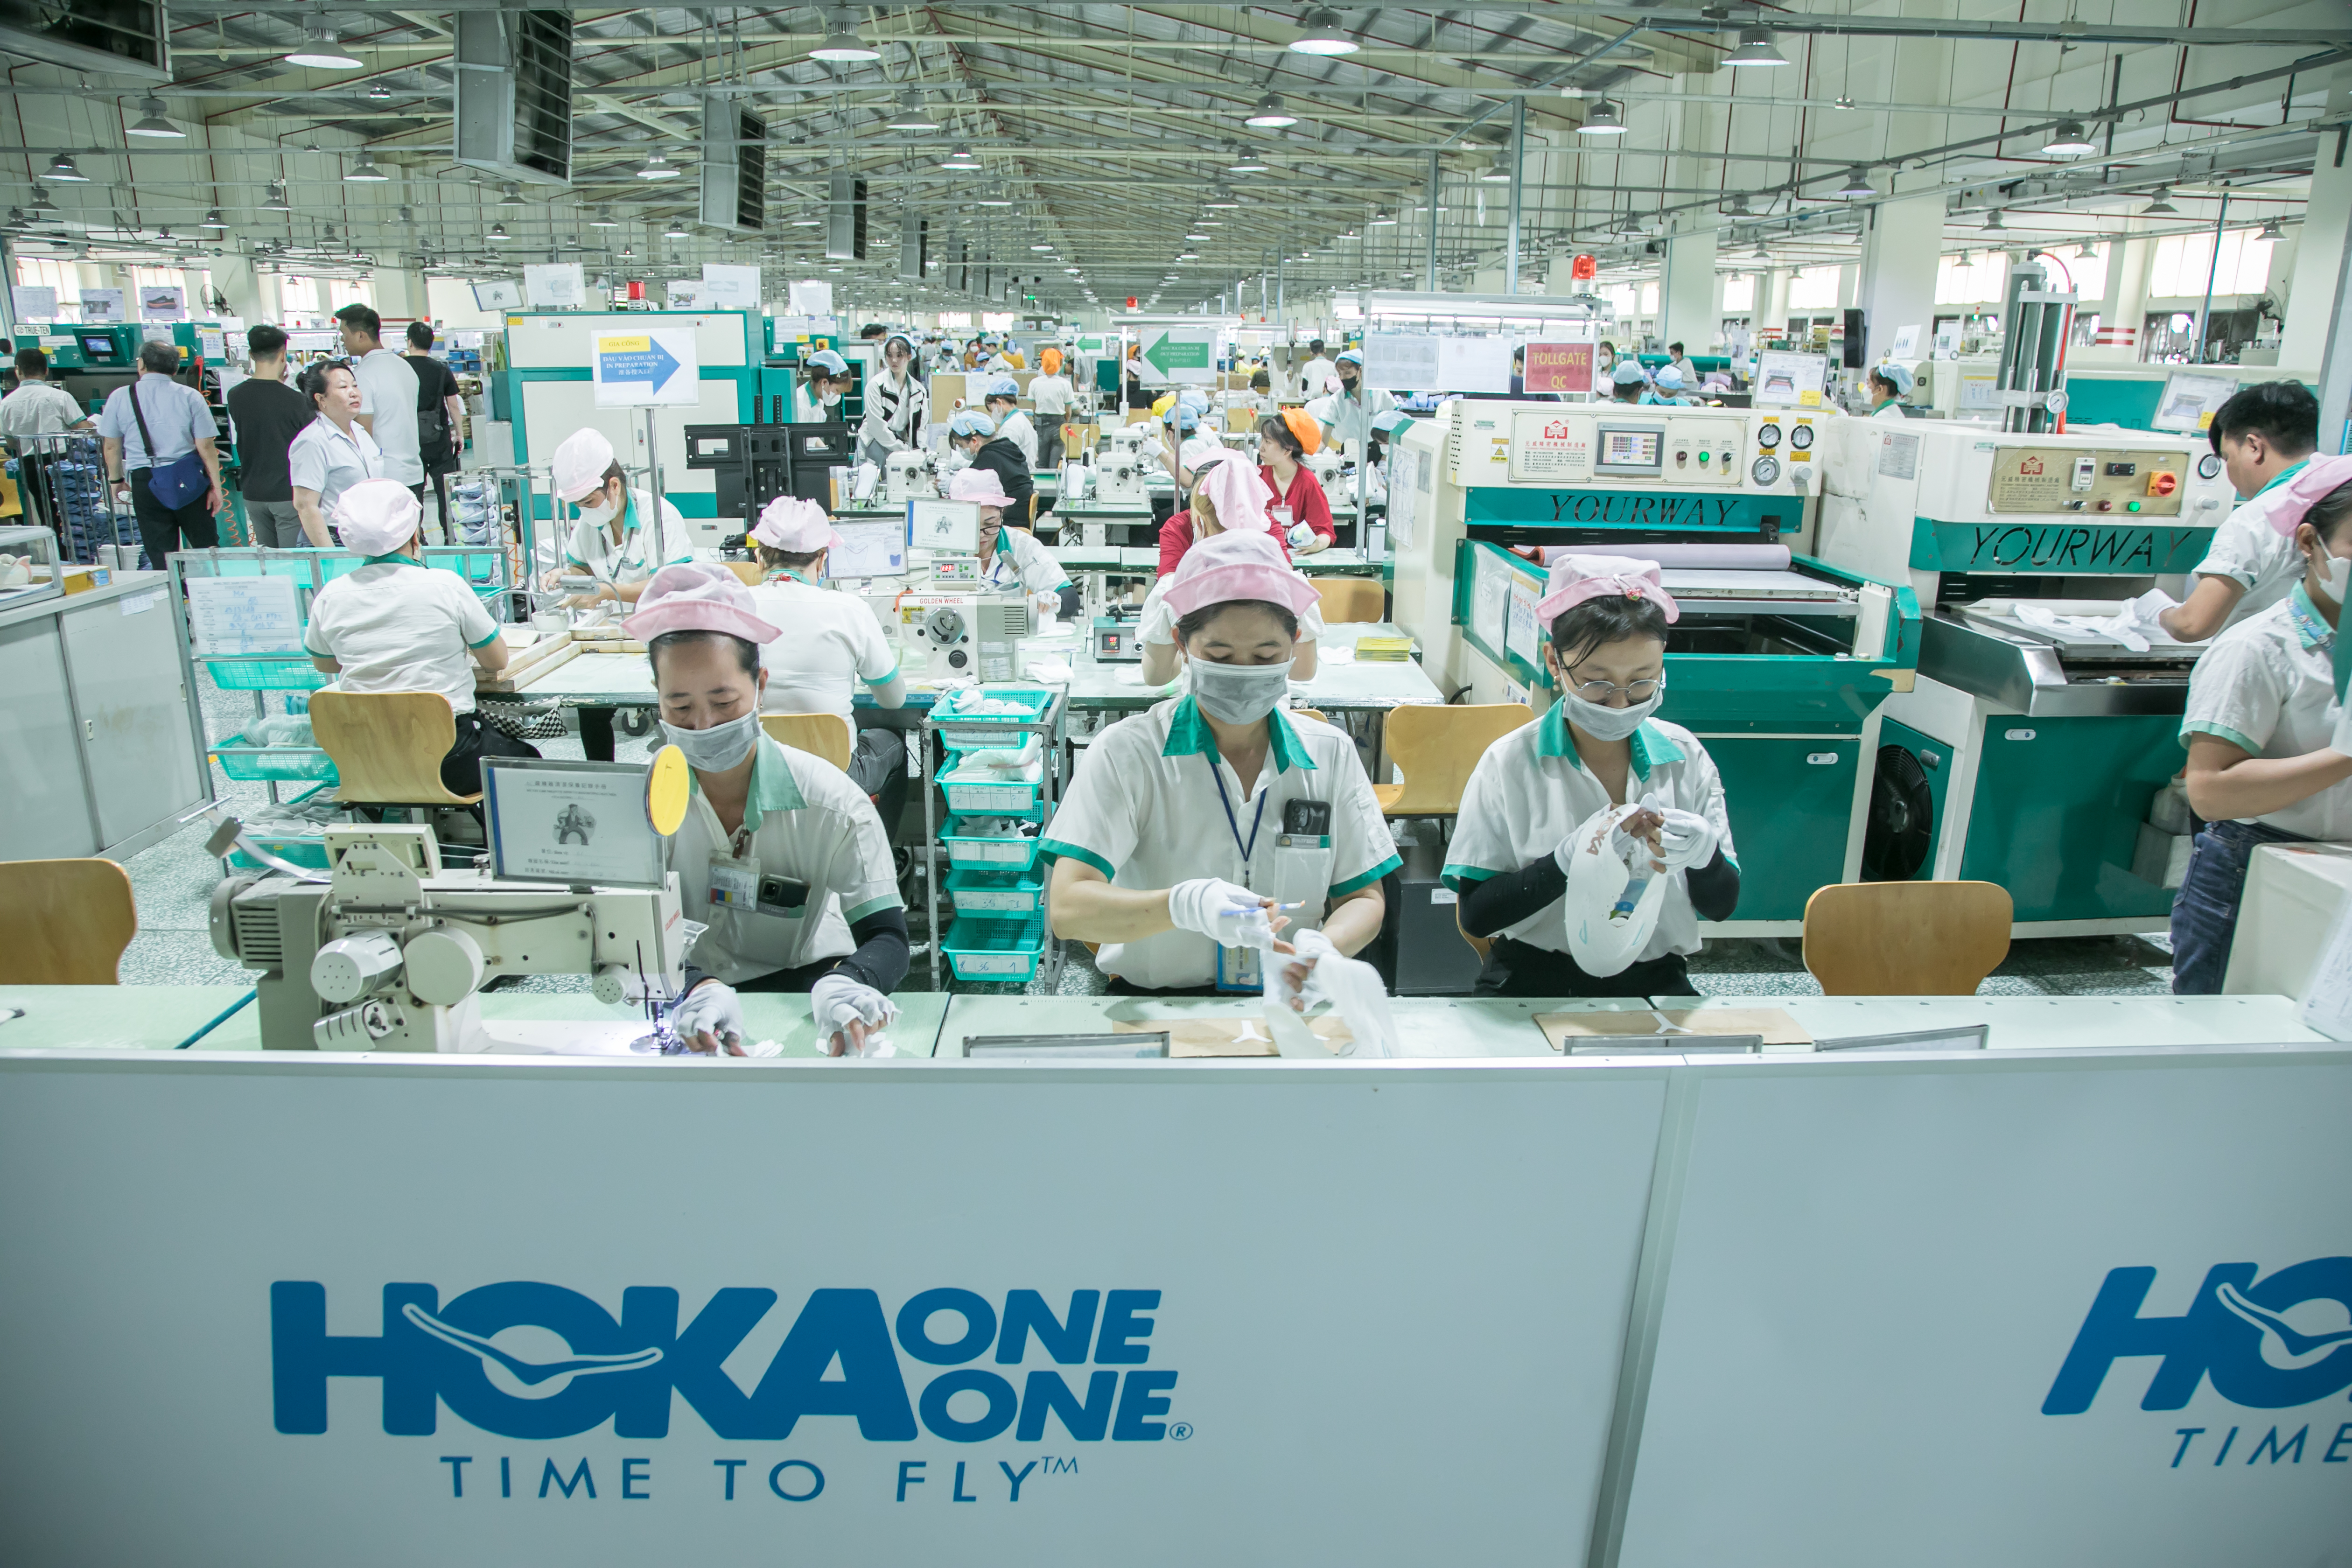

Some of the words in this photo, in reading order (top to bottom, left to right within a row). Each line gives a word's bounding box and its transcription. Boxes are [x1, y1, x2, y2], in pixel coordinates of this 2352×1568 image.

[1533, 352, 1587, 366] TOLLGATE
[1551, 376, 1567, 390] QC
[1549, 495, 1741, 525] YOURWAY
[1970, 527, 2193, 567] YOURWAY
[1586, 811, 1622, 856] HOKA
[896, 1287, 1162, 1366] ONE
[2041, 1255, 2352, 1416] HO
[270, 1280, 918, 1442] HOKA
[2170, 1422, 2352, 1469] TIME
[440, 1456, 650, 1500] TIME
[713, 1459, 825, 1502] TO
